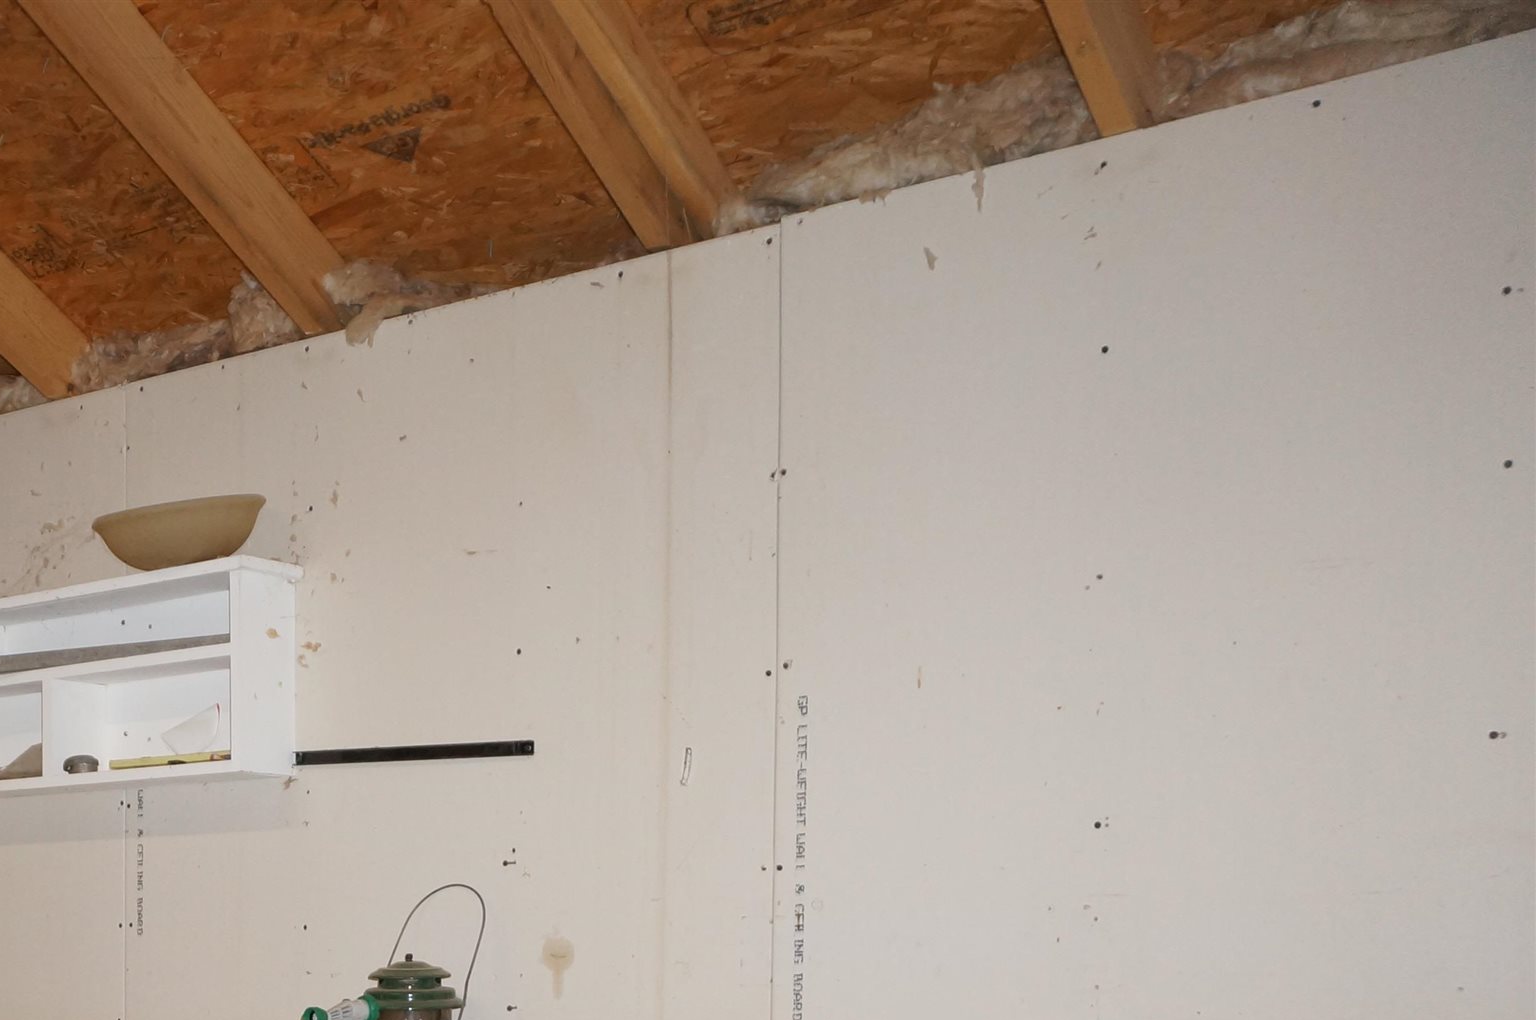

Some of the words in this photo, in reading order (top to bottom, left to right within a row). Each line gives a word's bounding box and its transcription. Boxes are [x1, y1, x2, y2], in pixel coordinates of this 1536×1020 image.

[797, 695, 809, 716] GP
[796, 724, 808, 827] LITE-WEIGHT
[795, 832, 806, 870] WALL
